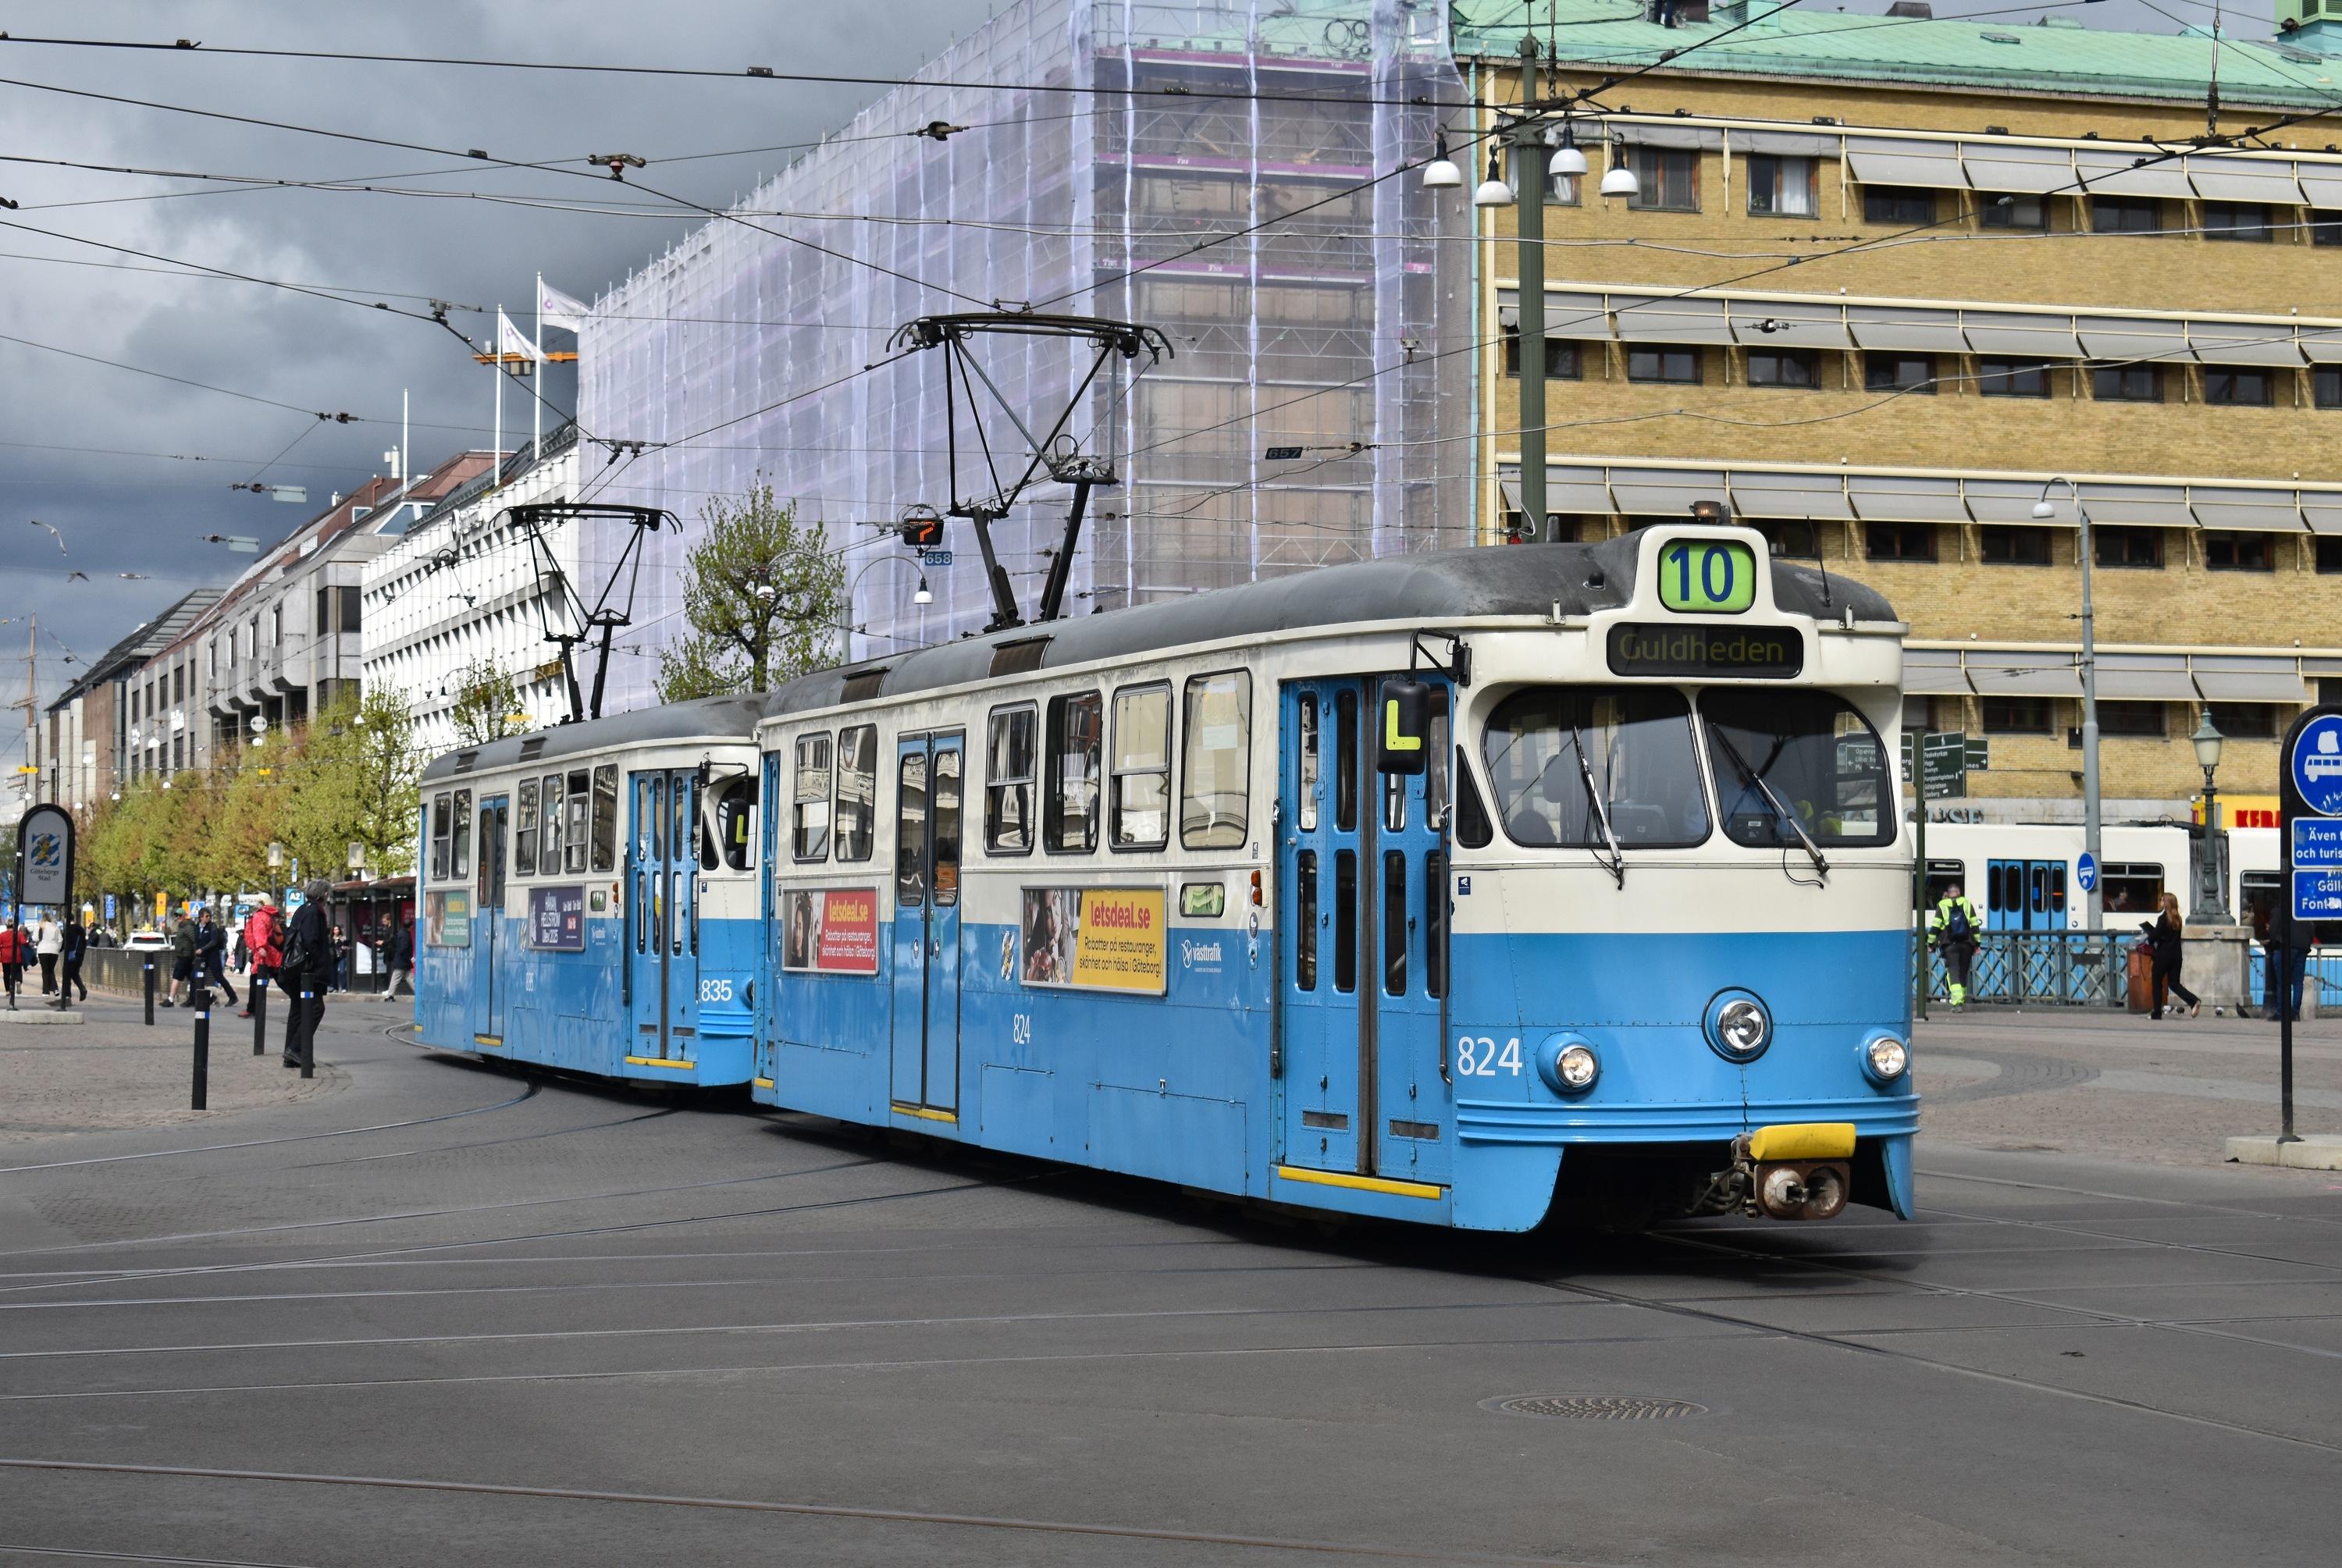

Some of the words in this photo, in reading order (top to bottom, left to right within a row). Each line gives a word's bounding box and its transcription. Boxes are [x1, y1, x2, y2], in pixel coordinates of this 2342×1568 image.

[1268, 448, 1301, 458] 657
[926, 553, 952, 564] 658
[1668, 546, 1734, 603] 10
[1619, 633, 1784, 663] Guldheden
[2308, 827, 2337, 841] Även
[2296, 848, 2316, 859] och
[2318, 880, 2342, 891] Gäll
[829, 899, 868, 922] letsdeal.se
[1091, 900, 1151, 929] letsdeal.se
[1084, 937, 1109, 950] Rabatter
[1109, 937, 1118, 954] på
[1118, 940, 1156, 957] restauranger,
[1193, 942, 1222, 962] västtrafik
[1079, 955, 1101, 970] skönhet
[1102, 958, 1112, 970] och
[1112, 957, 1128, 971] hälsa
[1132, 958, 1162, 977] Göteborg!
[702, 980, 732, 1001] 835
[1013, 1014, 1030, 1044] 824
[1458, 1036, 1523, 1076] 824
